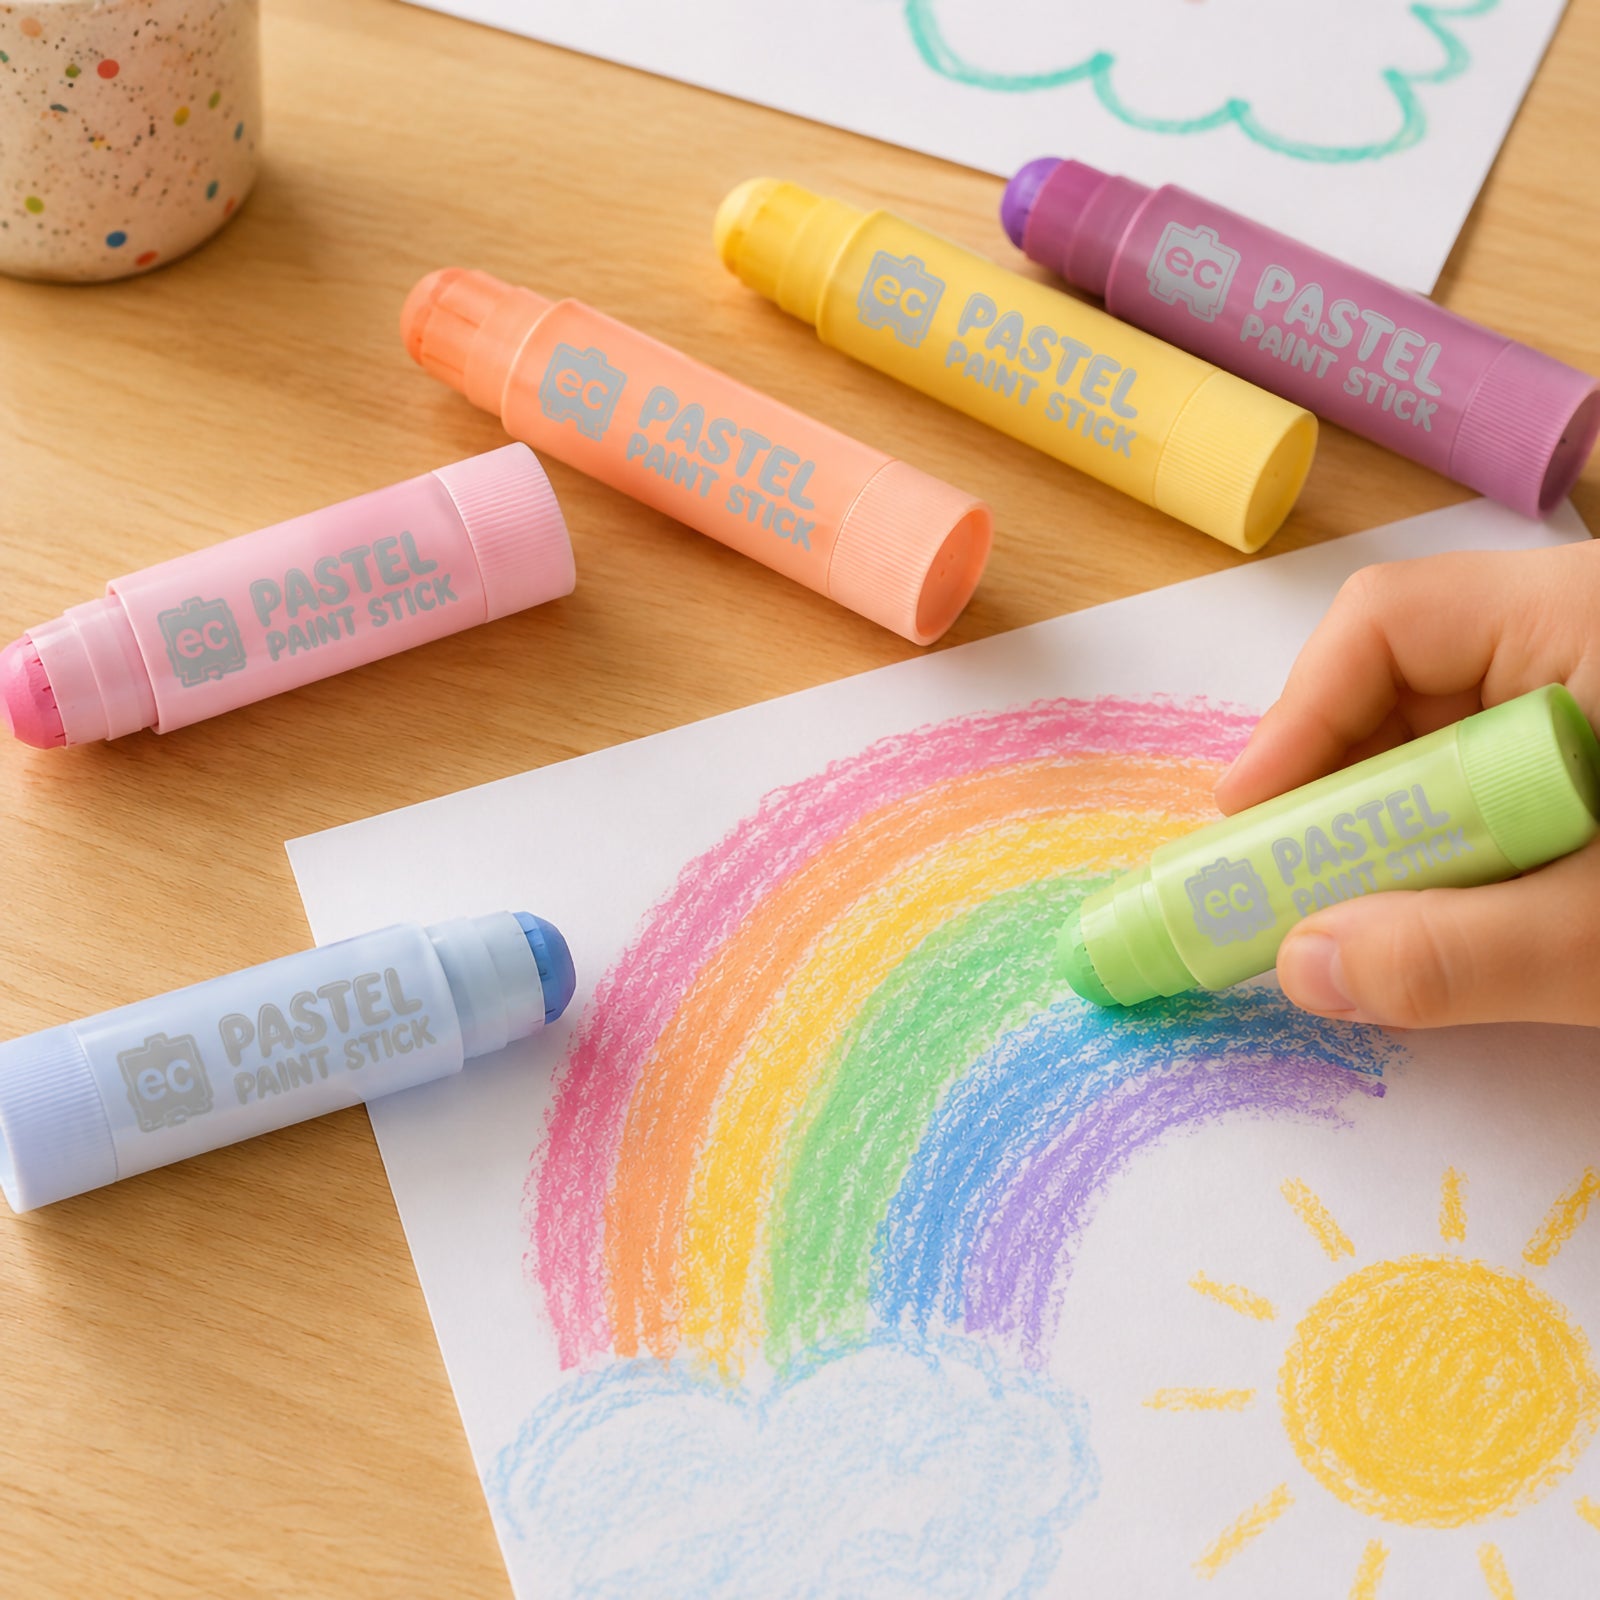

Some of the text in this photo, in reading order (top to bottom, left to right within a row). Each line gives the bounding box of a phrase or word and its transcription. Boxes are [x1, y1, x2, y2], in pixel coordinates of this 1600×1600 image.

[958, 293, 1138, 419] PASTEL
[1240, 314, 1439, 432] PAINT STICK
[1253, 264, 1442, 396] PASTEL
[638, 386, 816, 510] PASTEL
[945, 340, 1138, 458] PAINT STICK
[626, 433, 816, 552] PAINT STICK
[249, 531, 438, 627] PASTEL
[265, 573, 458, 661] PAINT STICK
[1272, 784, 1450, 886] PASTEL
[1291, 827, 1474, 916] PAINT STICK
[218, 968, 423, 1067] PASTEL
[233, 1015, 436, 1104] PAINT STICK
